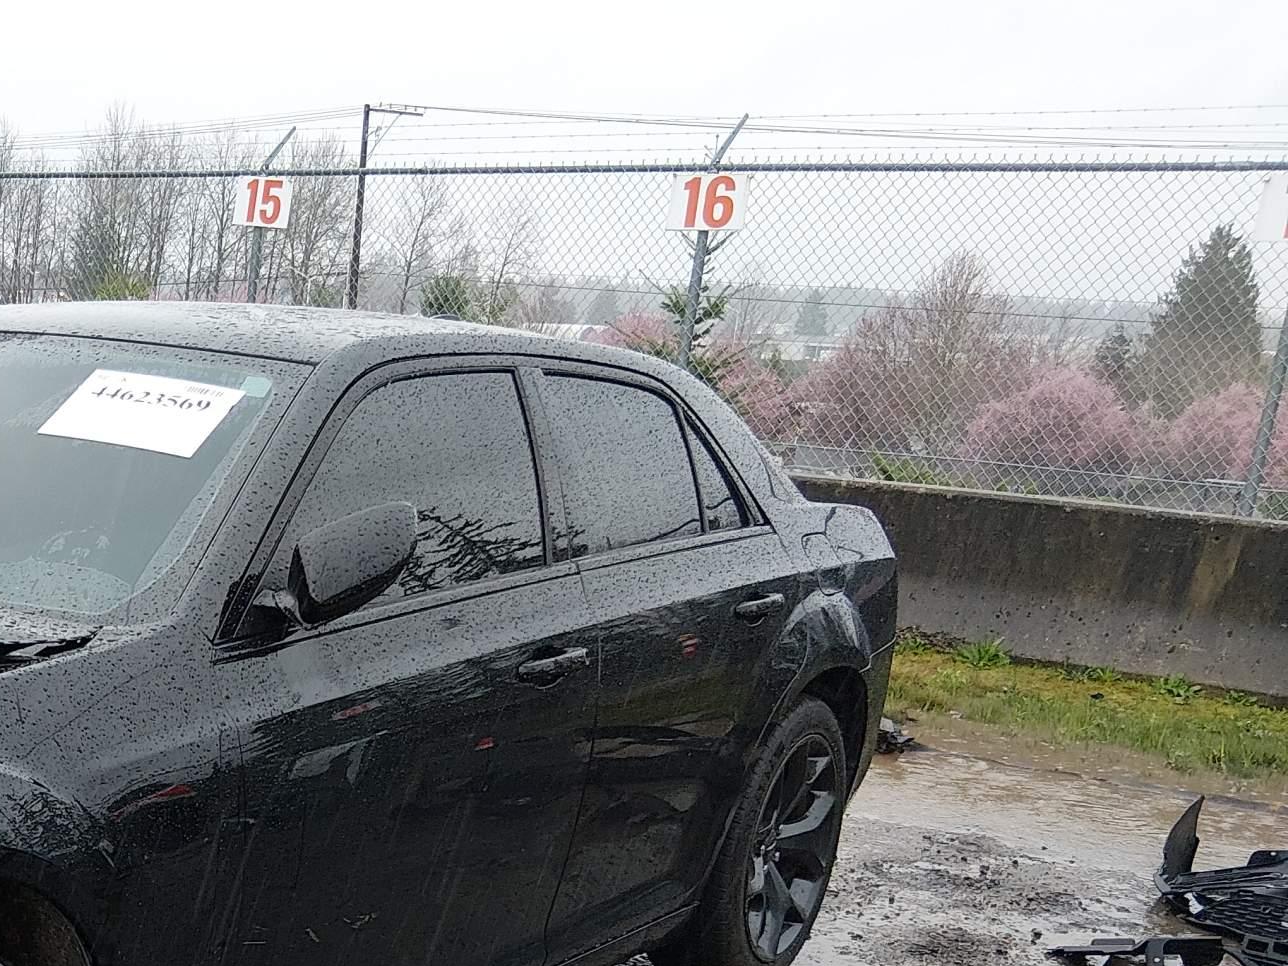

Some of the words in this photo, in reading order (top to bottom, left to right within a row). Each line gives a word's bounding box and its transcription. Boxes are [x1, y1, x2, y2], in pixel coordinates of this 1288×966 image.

[246, 178, 283, 225] 15
[683, 175, 736, 229] 16
[91, 385, 212, 412] 44623569
